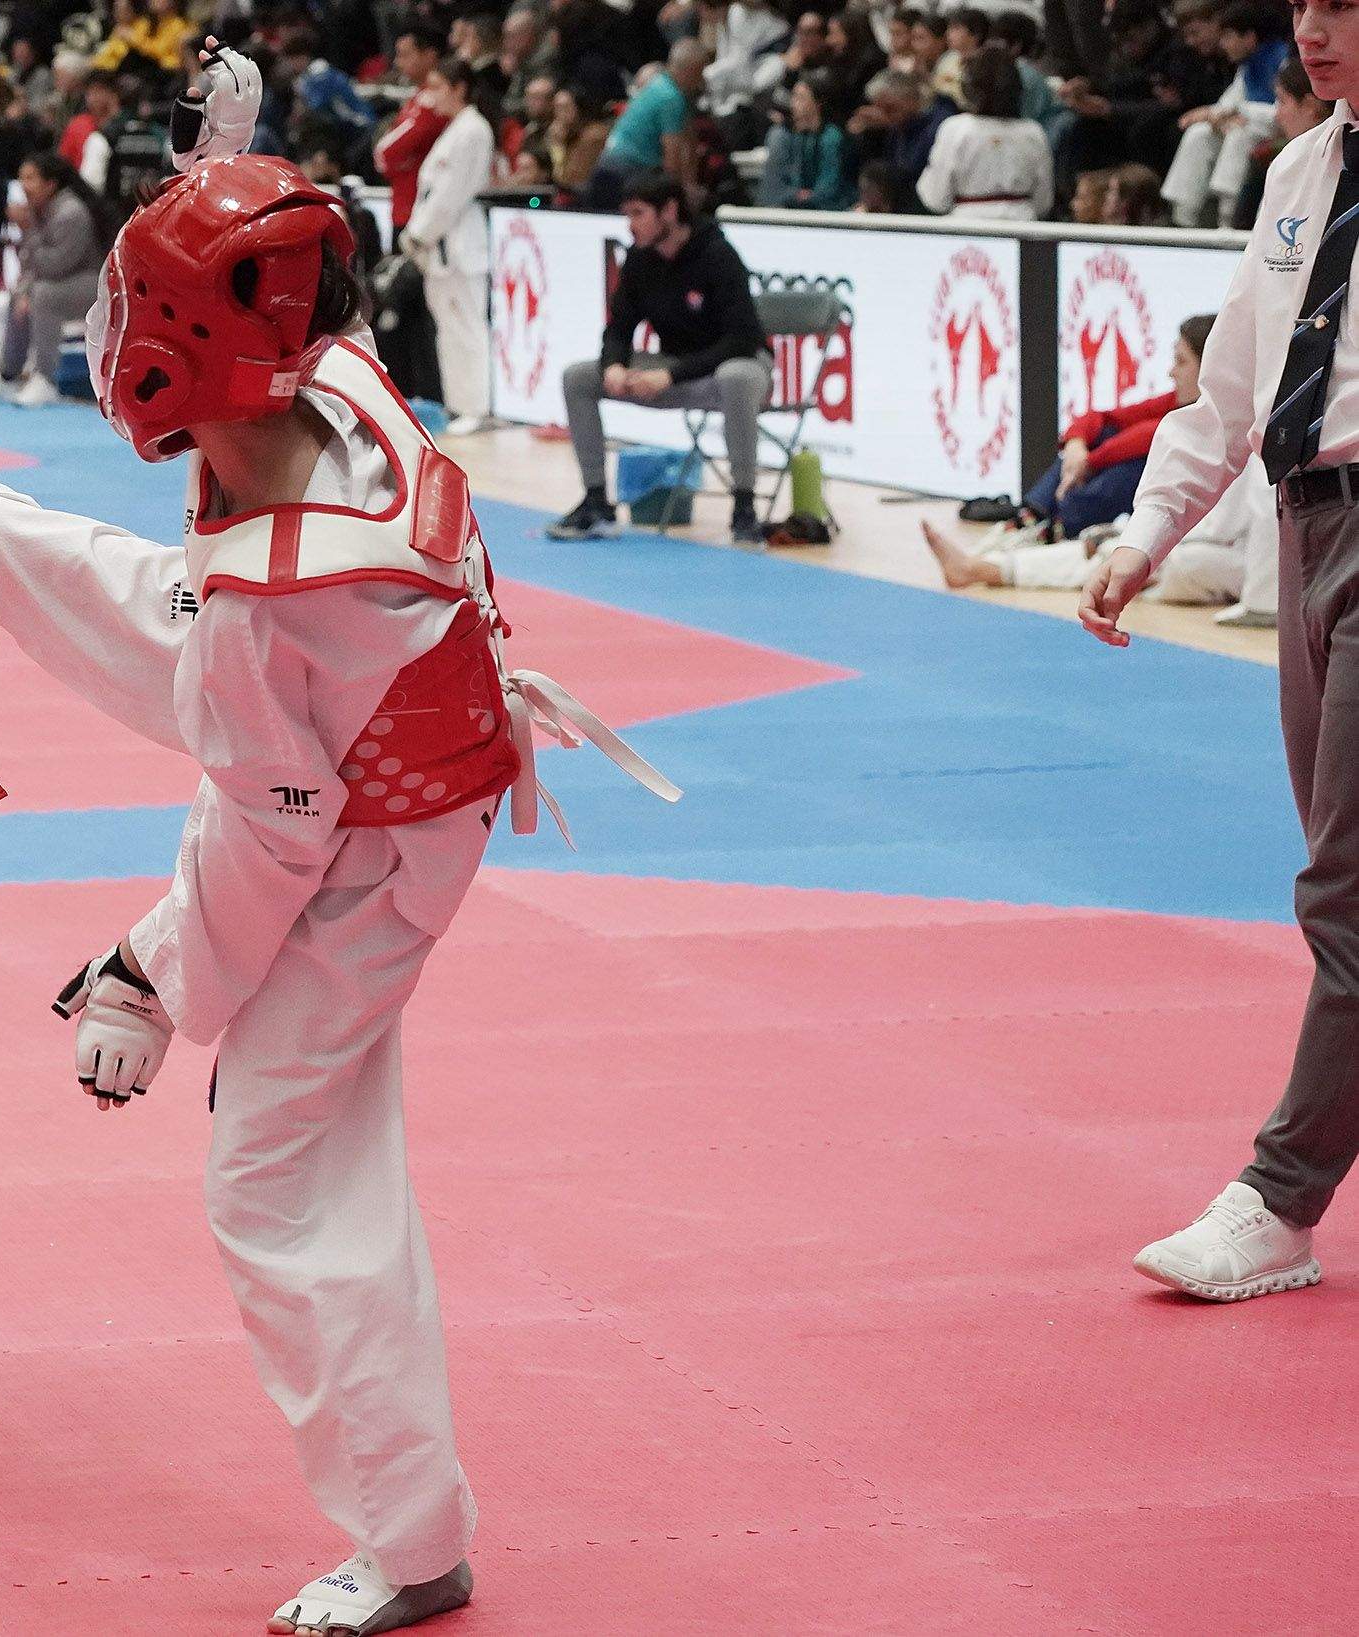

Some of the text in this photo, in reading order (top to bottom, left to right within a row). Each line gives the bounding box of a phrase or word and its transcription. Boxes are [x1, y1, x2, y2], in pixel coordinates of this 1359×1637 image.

[170, 582, 182, 620] TUSAH
[275, 807, 320, 817] TUSAH
[319, 1576, 359, 1594] Daedo
